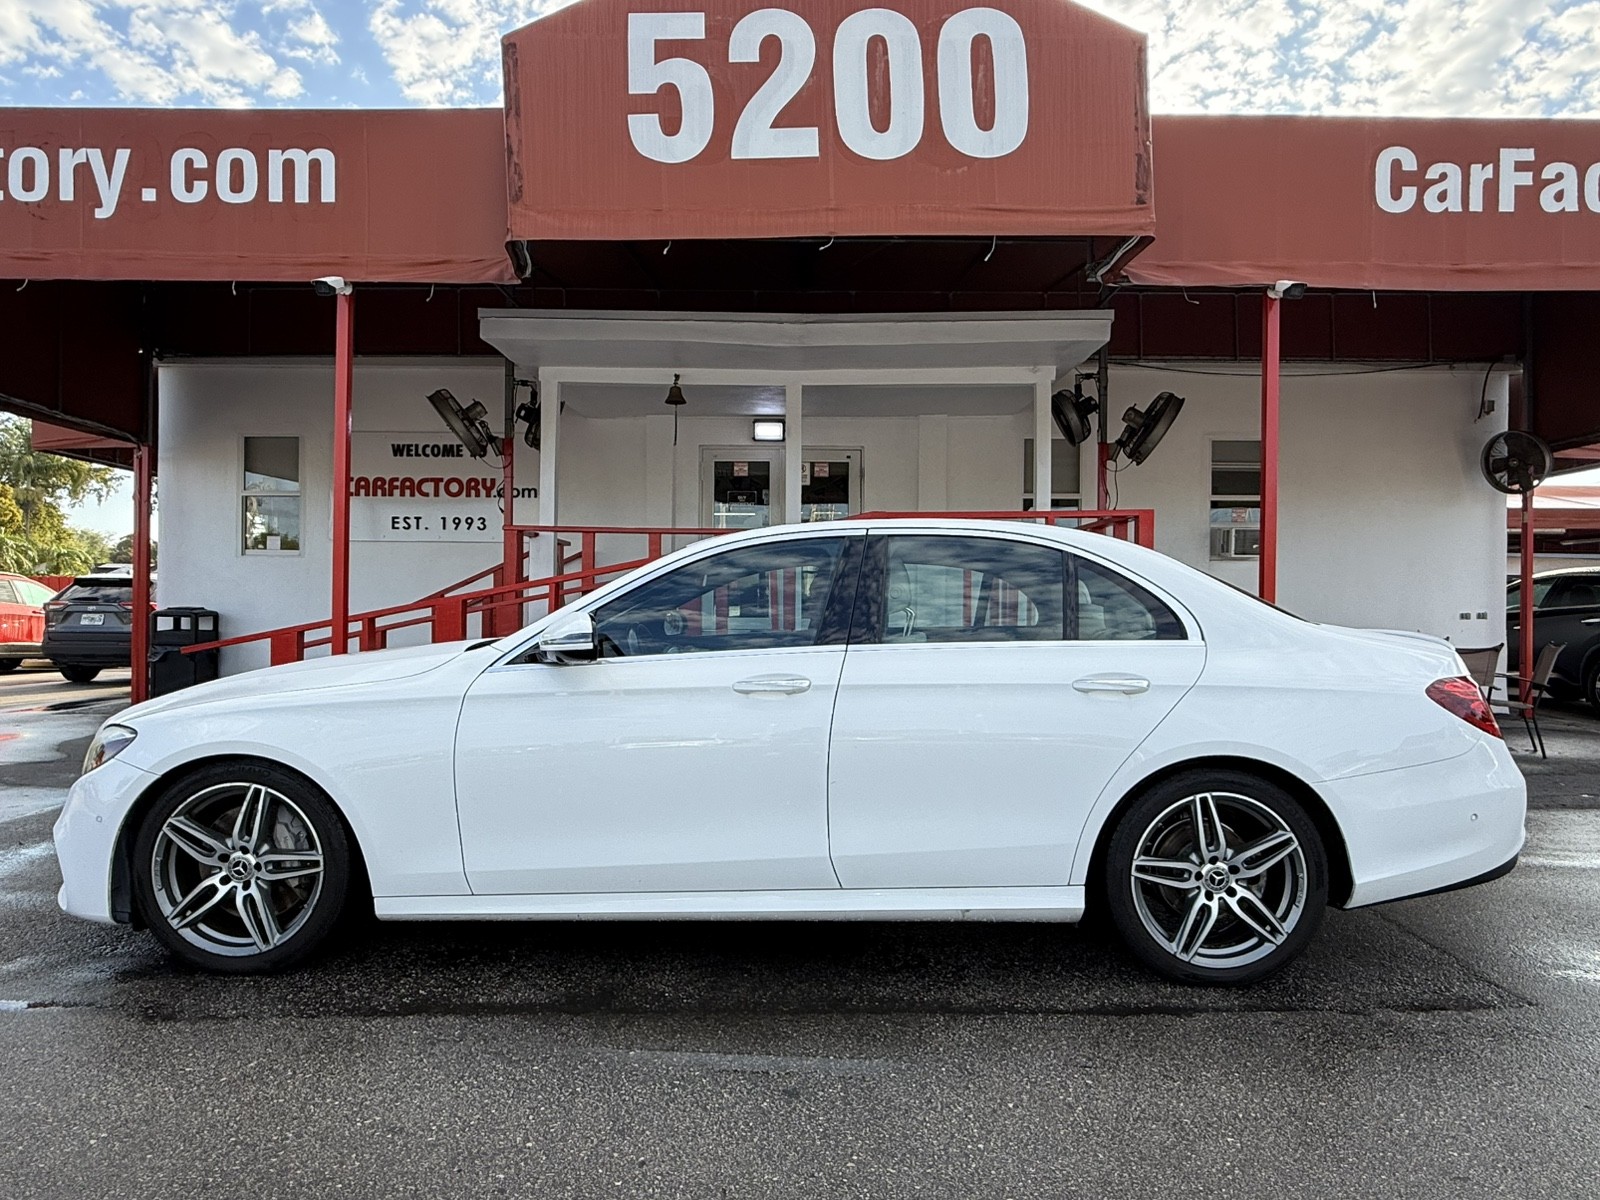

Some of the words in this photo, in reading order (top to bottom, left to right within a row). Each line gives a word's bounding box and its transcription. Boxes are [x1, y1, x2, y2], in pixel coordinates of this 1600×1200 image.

[628, 7, 1029, 164] 5200
[0, 147, 337, 219] ory.com
[391, 443, 464, 458] WELCOME
[391, 516, 429, 530] EST.
[440, 516, 487, 531] 1993
